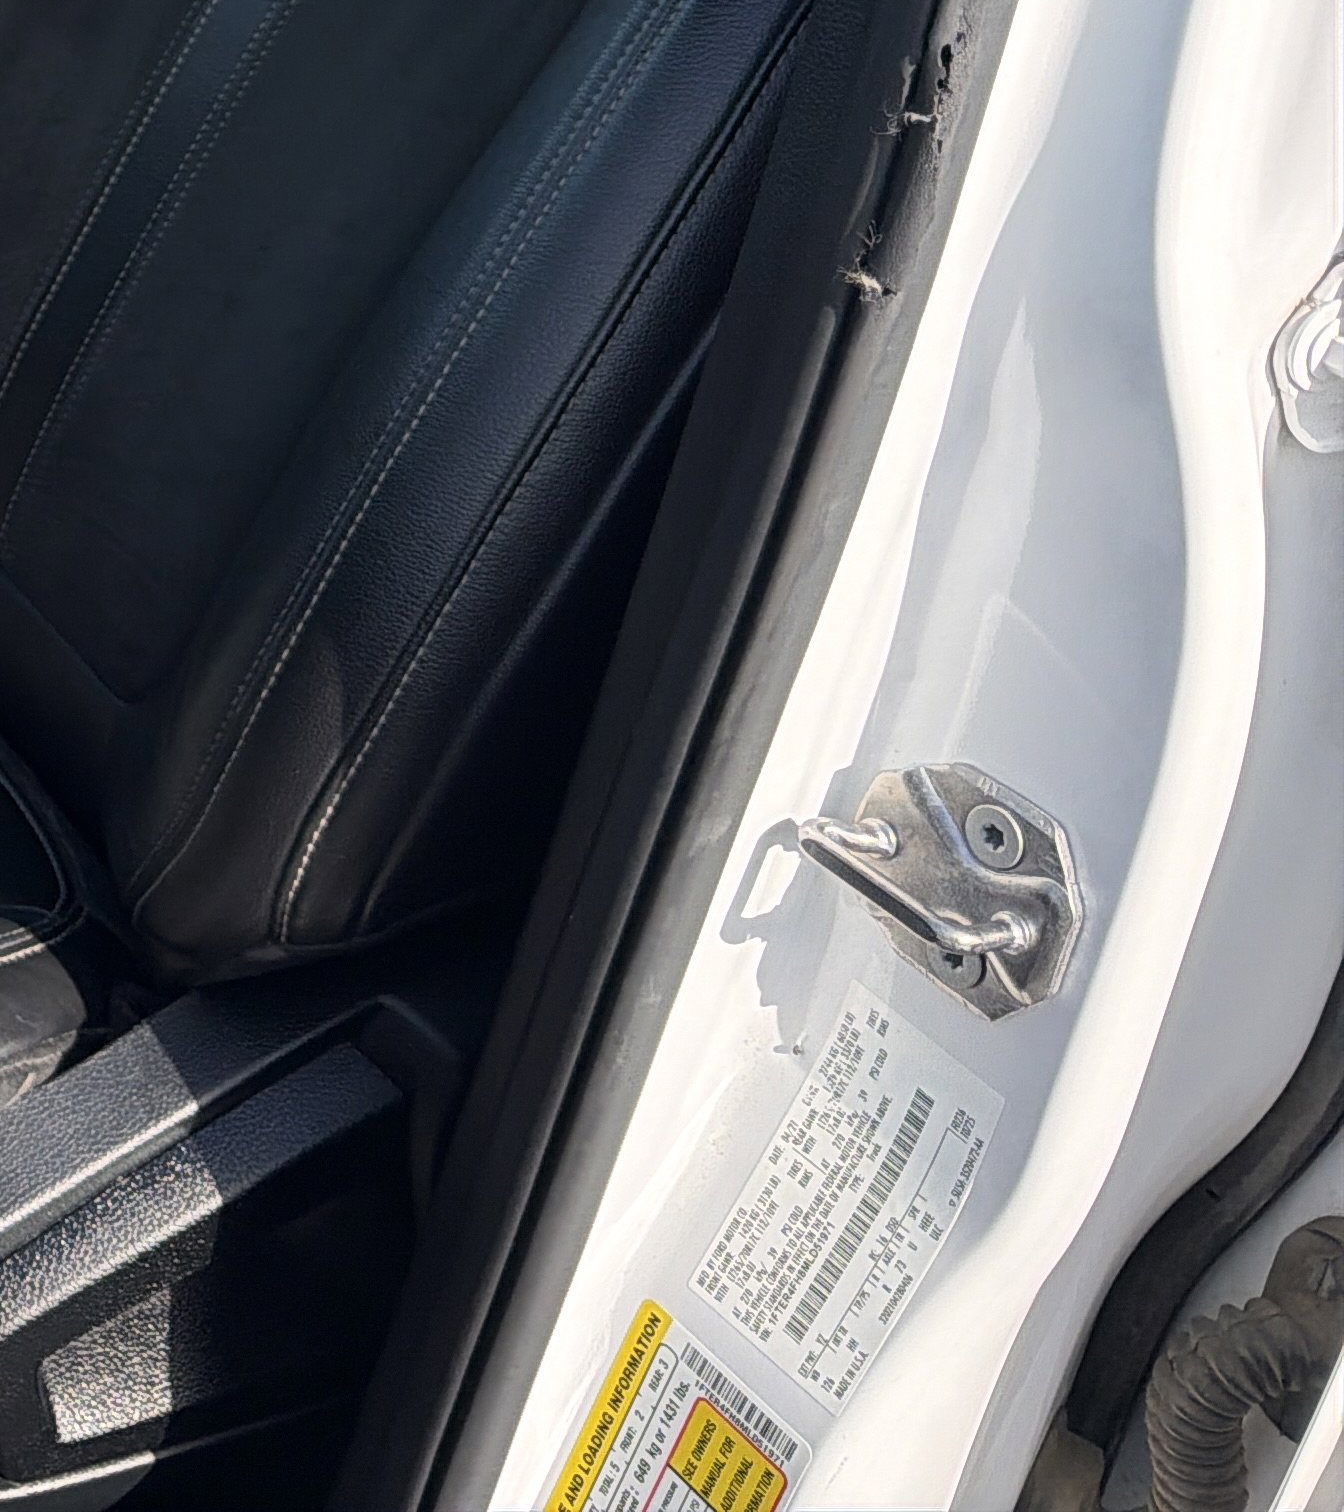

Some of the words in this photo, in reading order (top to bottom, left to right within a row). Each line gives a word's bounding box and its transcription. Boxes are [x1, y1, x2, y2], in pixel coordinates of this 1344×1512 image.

[768, 1142, 785, 1165] DATE:
[801, 1134, 817, 1154] WITH
[786, 1158, 803, 1179] TIRES
[820, 1157, 831, 1170] AT
[740, 1308, 755, 1326] THIS
[749, 1283, 770, 1311] VEHICLE
[765, 1248, 791, 1286] CONFORMS
[786, 1238, 797, 1250] TO
[792, 1226, 804, 1241] ALL
[799, 1188, 826, 1229] APPLICABLE
[821, 1160, 842, 1191] FEDERAL
[837, 1136, 856, 1163] MOTOR
[851, 1110, 871, 1139] VEHICLE
[749, 1308, 768, 1334] SAFETY
[763, 1270, 791, 1312] STANDARDS
[785, 1262, 796, 1274] IN
[791, 1240, 809, 1266] EFFECT
[804, 1229, 816, 1244] ON
[811, 1217, 823, 1232] THE
[818, 1199, 834, 1219] DATE
[828, 1189, 840, 1202] OF
[834, 1142, 867, 1193] MANUFACTURE
[861, 1117, 880, 1145] SHOWN
[704, 1271, 722, 1295] FRONT
[738, 1218, 753, 1239] 1420
[747, 1207, 760, 1222] KG
[705, 1258, 716, 1270] BY
[711, 1239, 727, 1261] FORD
[722, 1216, 741, 1243] MOTOR
[880, 1246, 896, 1266] AXLE
[731, 1306, 742, 1319] AT
[787, 1204, 803, 1225] COLD
[713, 1282, 729, 1303] WITH
[657, 1357, 669, 1370] 3
[671, 1378, 689, 1402] lbs.
[832, 1375, 851, 1400] MADE
[844, 1367, 856, 1381] IN
[563, 1472, 584, 1506] AND
[577, 1410, 614, 1475] LOADING
[607, 1310, 661, 1413] INFORMATION
[633, 1408, 645, 1421] 2
[658, 1397, 679, 1428] 1431
[654, 1426, 667, 1444] or
[681, 1457, 698, 1481] SEE
[690, 1417, 717, 1462] OWNERS
[644, 1442, 662, 1461] kg
[631, 1456, 651, 1484] 649
[699, 1456, 725, 1499] MANUAL
[718, 1434, 735, 1459] FOR
[719, 1455, 753, 1512] ADDITIONAL
[745, 1466, 775, 1512] RMATION
